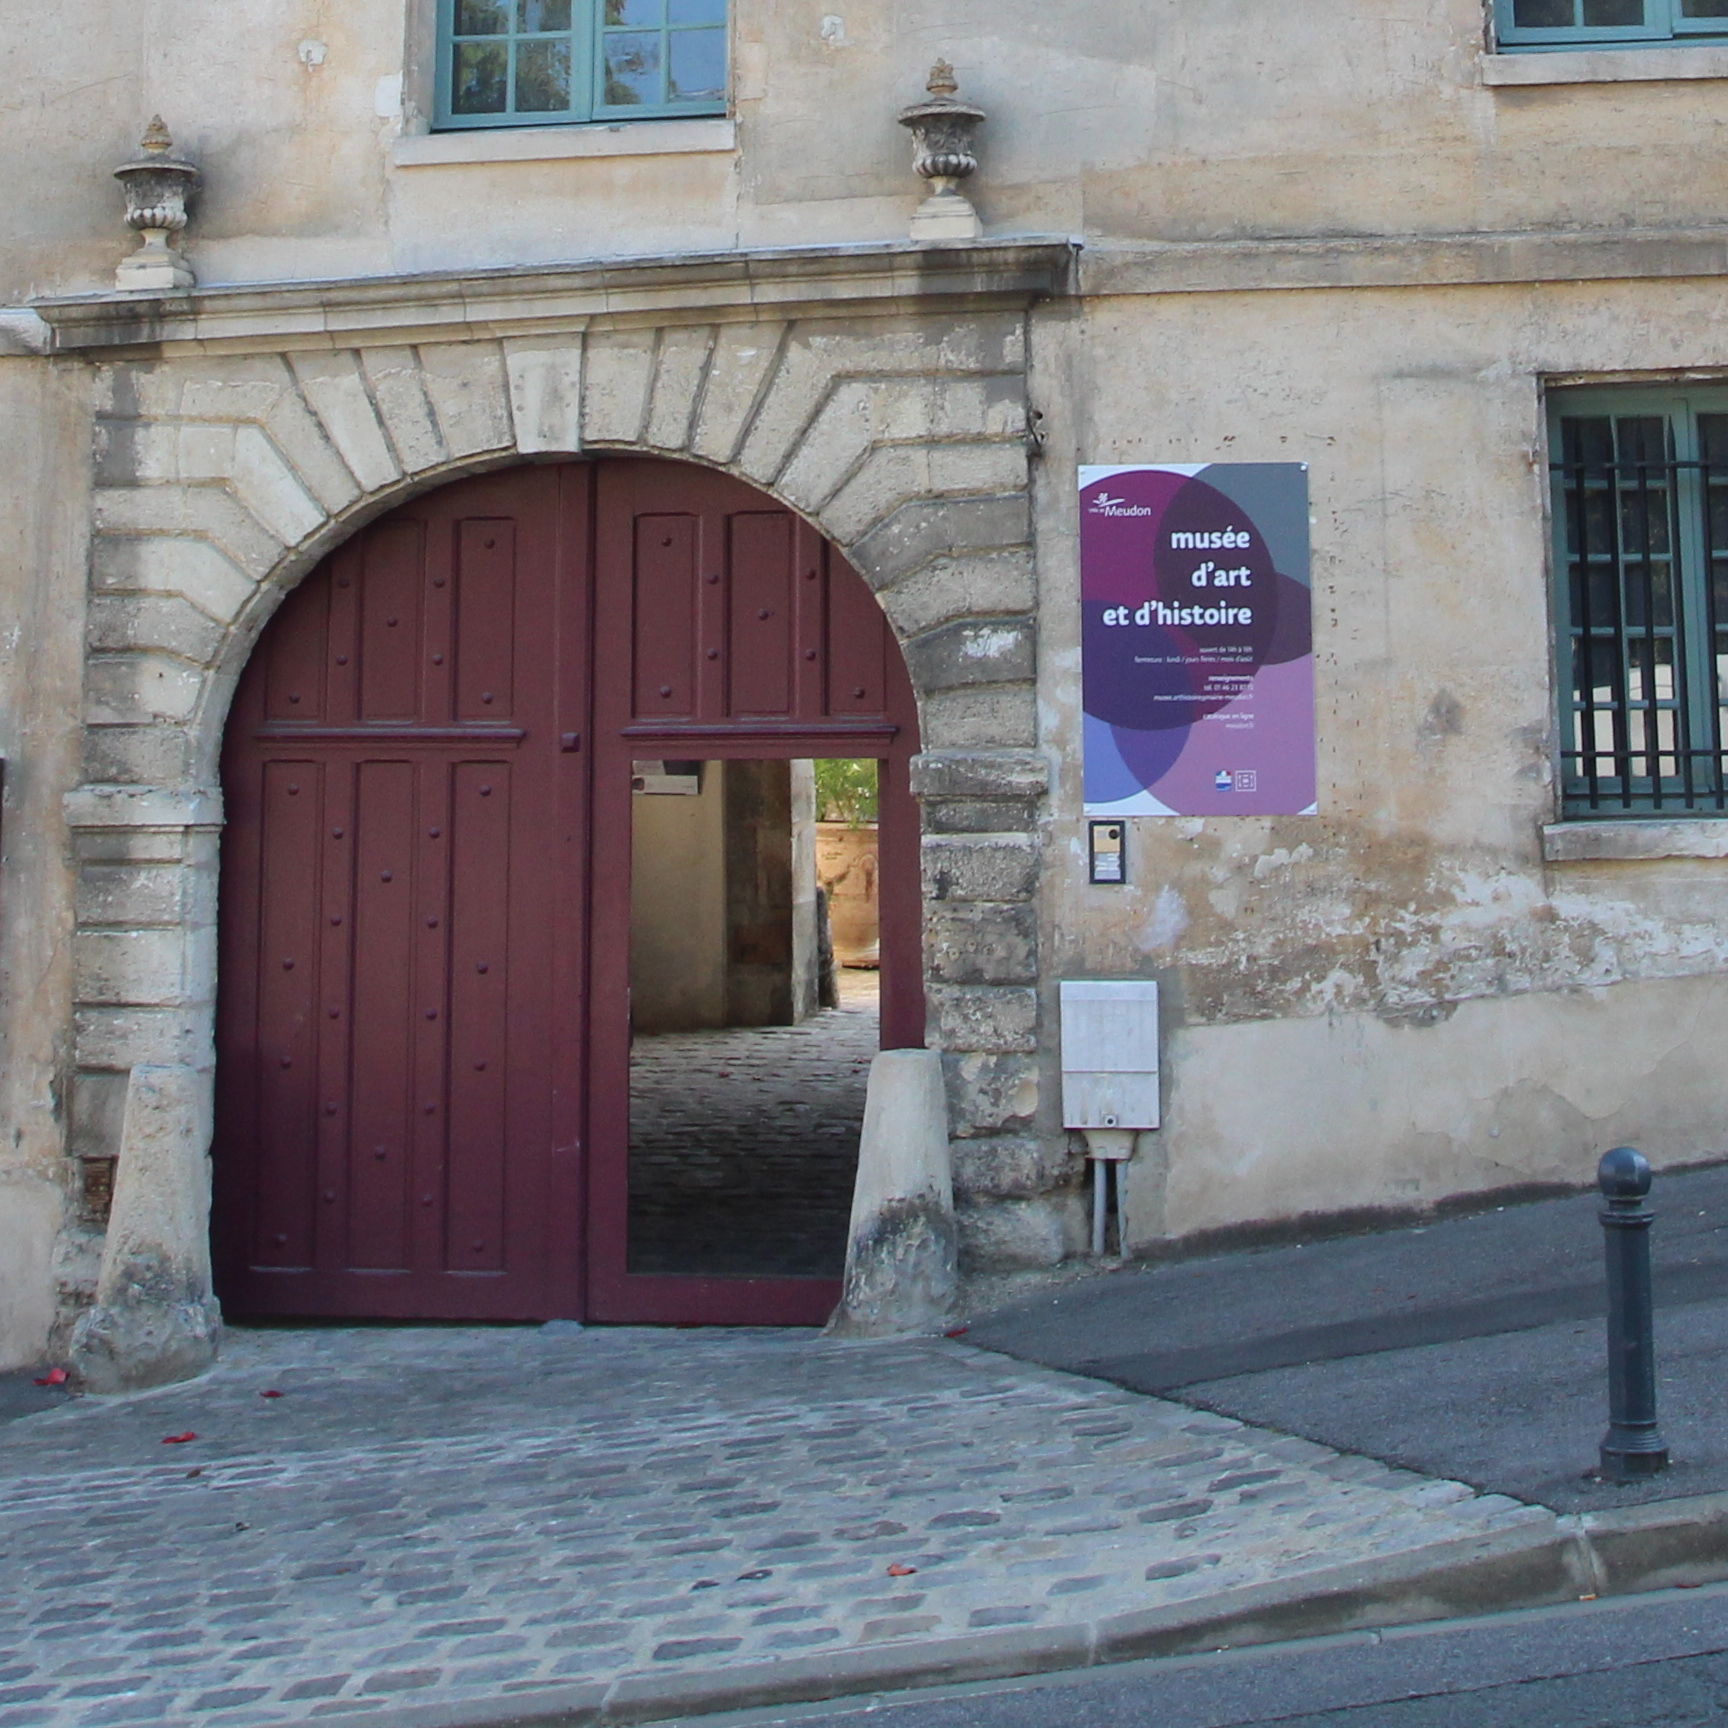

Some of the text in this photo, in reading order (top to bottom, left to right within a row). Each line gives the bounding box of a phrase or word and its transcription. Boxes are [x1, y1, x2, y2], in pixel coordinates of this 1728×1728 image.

[1104, 504, 1152, 517] Meudon
[1171, 525, 1251, 549] musée
[1191, 561, 1252, 587] d’art
[1102, 600, 1252, 626] et d’histoire
